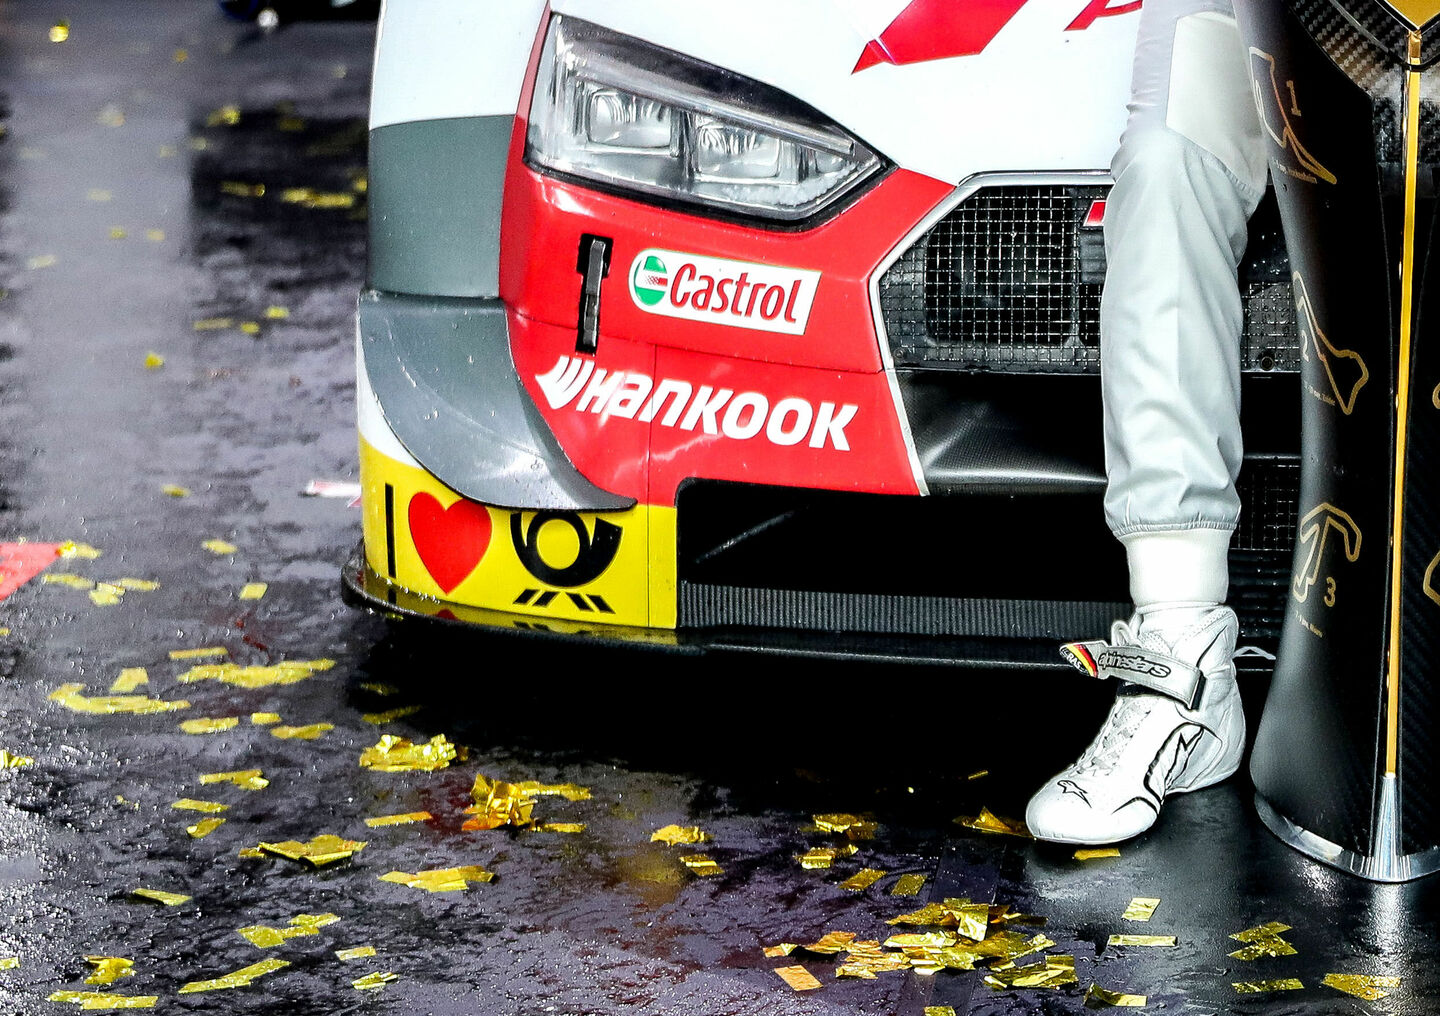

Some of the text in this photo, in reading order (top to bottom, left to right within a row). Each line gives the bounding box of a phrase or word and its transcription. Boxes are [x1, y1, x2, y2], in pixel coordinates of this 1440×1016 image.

[665, 262, 803, 324] Castrol
[1323, 576, 1336, 607] 3
[1098, 651, 1172, 678] alpinestars
